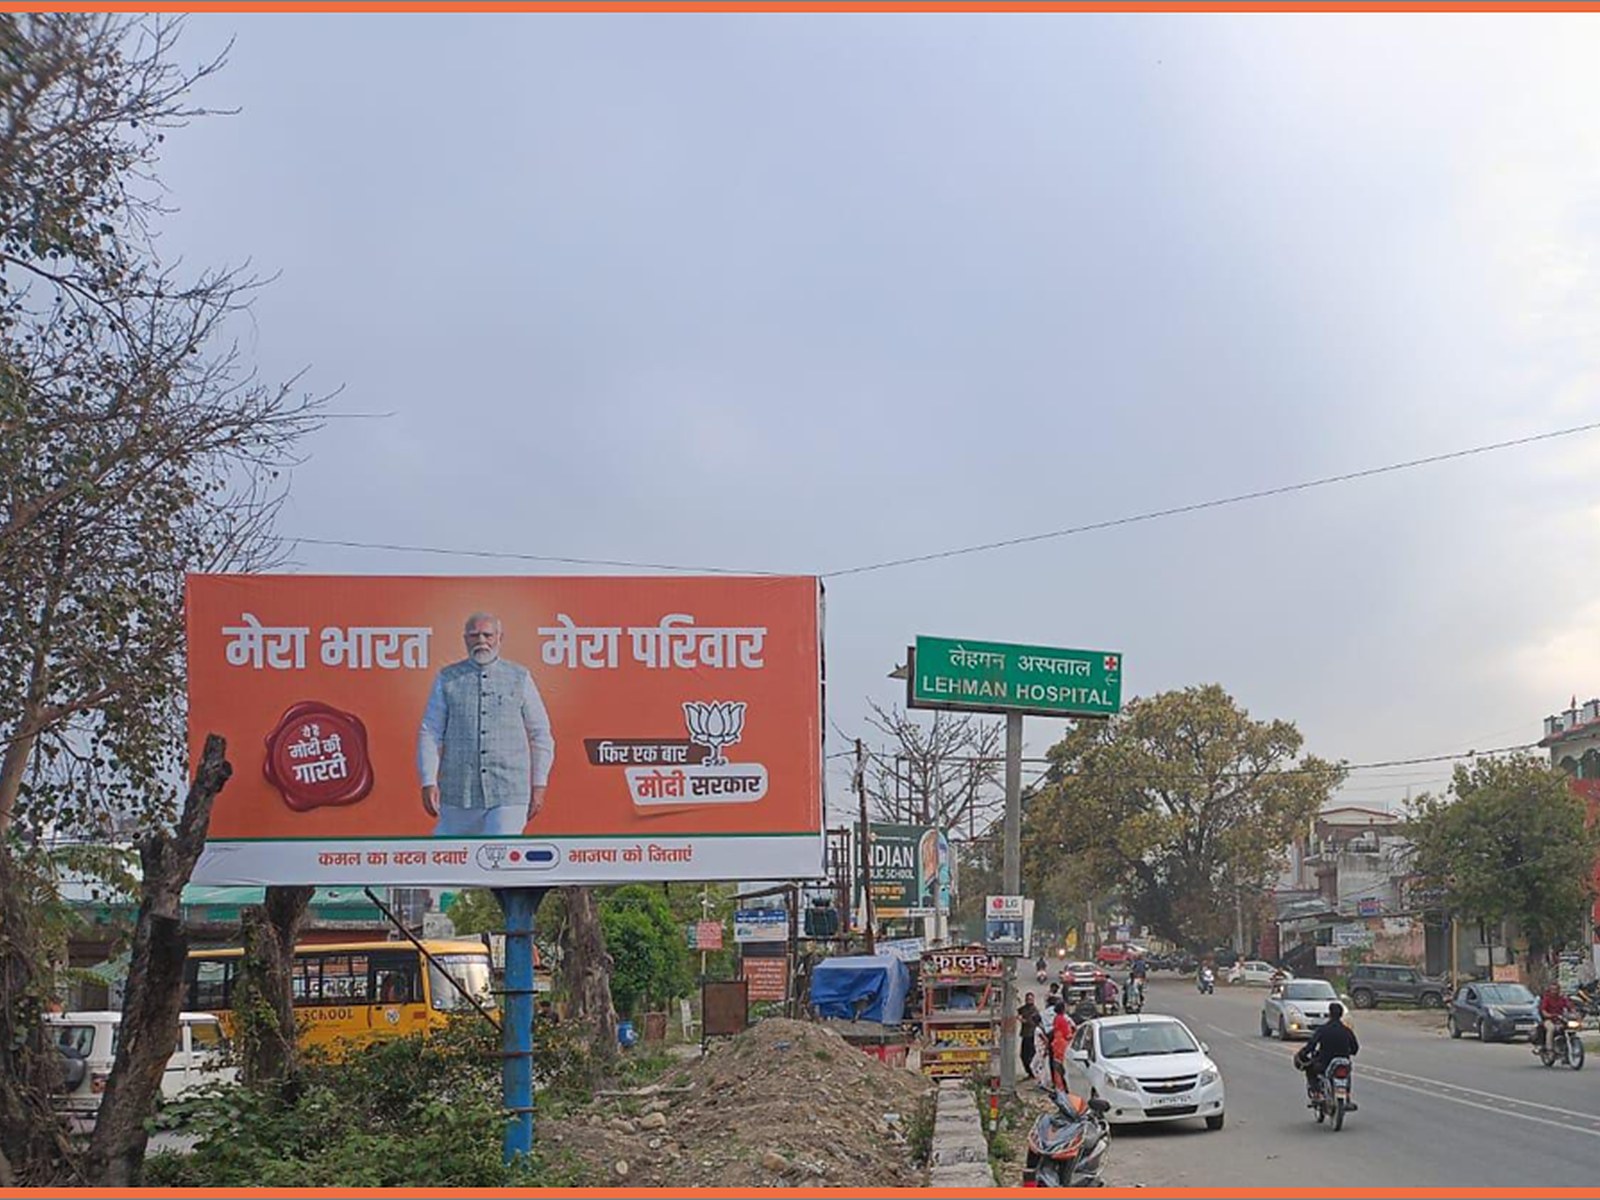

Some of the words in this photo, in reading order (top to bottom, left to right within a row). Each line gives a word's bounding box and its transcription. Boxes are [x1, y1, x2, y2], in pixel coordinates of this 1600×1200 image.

[222, 613, 311, 669] मेरा
[320, 626, 433, 669] भारत
[537, 613, 622, 669] मेरा
[627, 613, 767, 669] परिवार
[1018, 655, 1092, 677] अस्पताल
[922, 676, 1008, 698] LEHMAN
[1016, 683, 1113, 706] HOSPITAL
[288, 737, 321, 758] मोदी
[321, 733, 342, 753] की
[597, 741, 630, 764] फिर
[631, 745, 659, 763] एक
[291, 752, 347, 784] गारंटी
[635, 766, 686, 798] मोदी
[690, 774, 762, 796] सरकार
[318, 852, 361, 866] कमल
[367, 851, 388, 865] का
[568, 849, 617, 863] भाजपा
[622, 845, 643, 862] को
[648, 844, 693, 862] जिताएं
[1005, 899, 1019, 909] LG
[303, 1008, 354, 1020] SCHOOL
